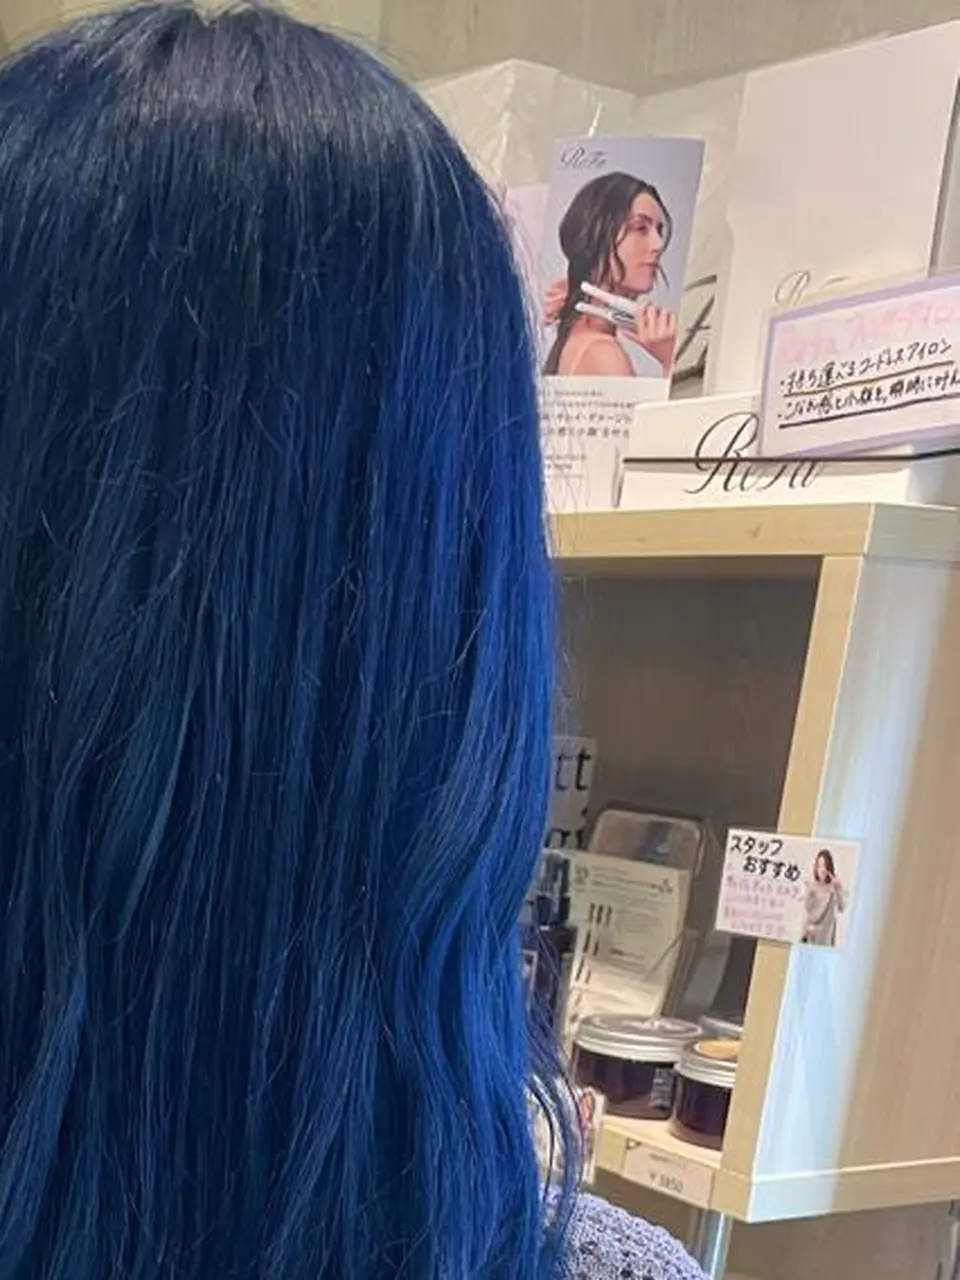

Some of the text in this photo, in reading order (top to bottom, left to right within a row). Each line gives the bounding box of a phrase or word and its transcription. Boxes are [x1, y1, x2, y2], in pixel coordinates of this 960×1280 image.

[730, 835, 784, 856] スタッフ
[743, 856, 801, 882] おすすめ
